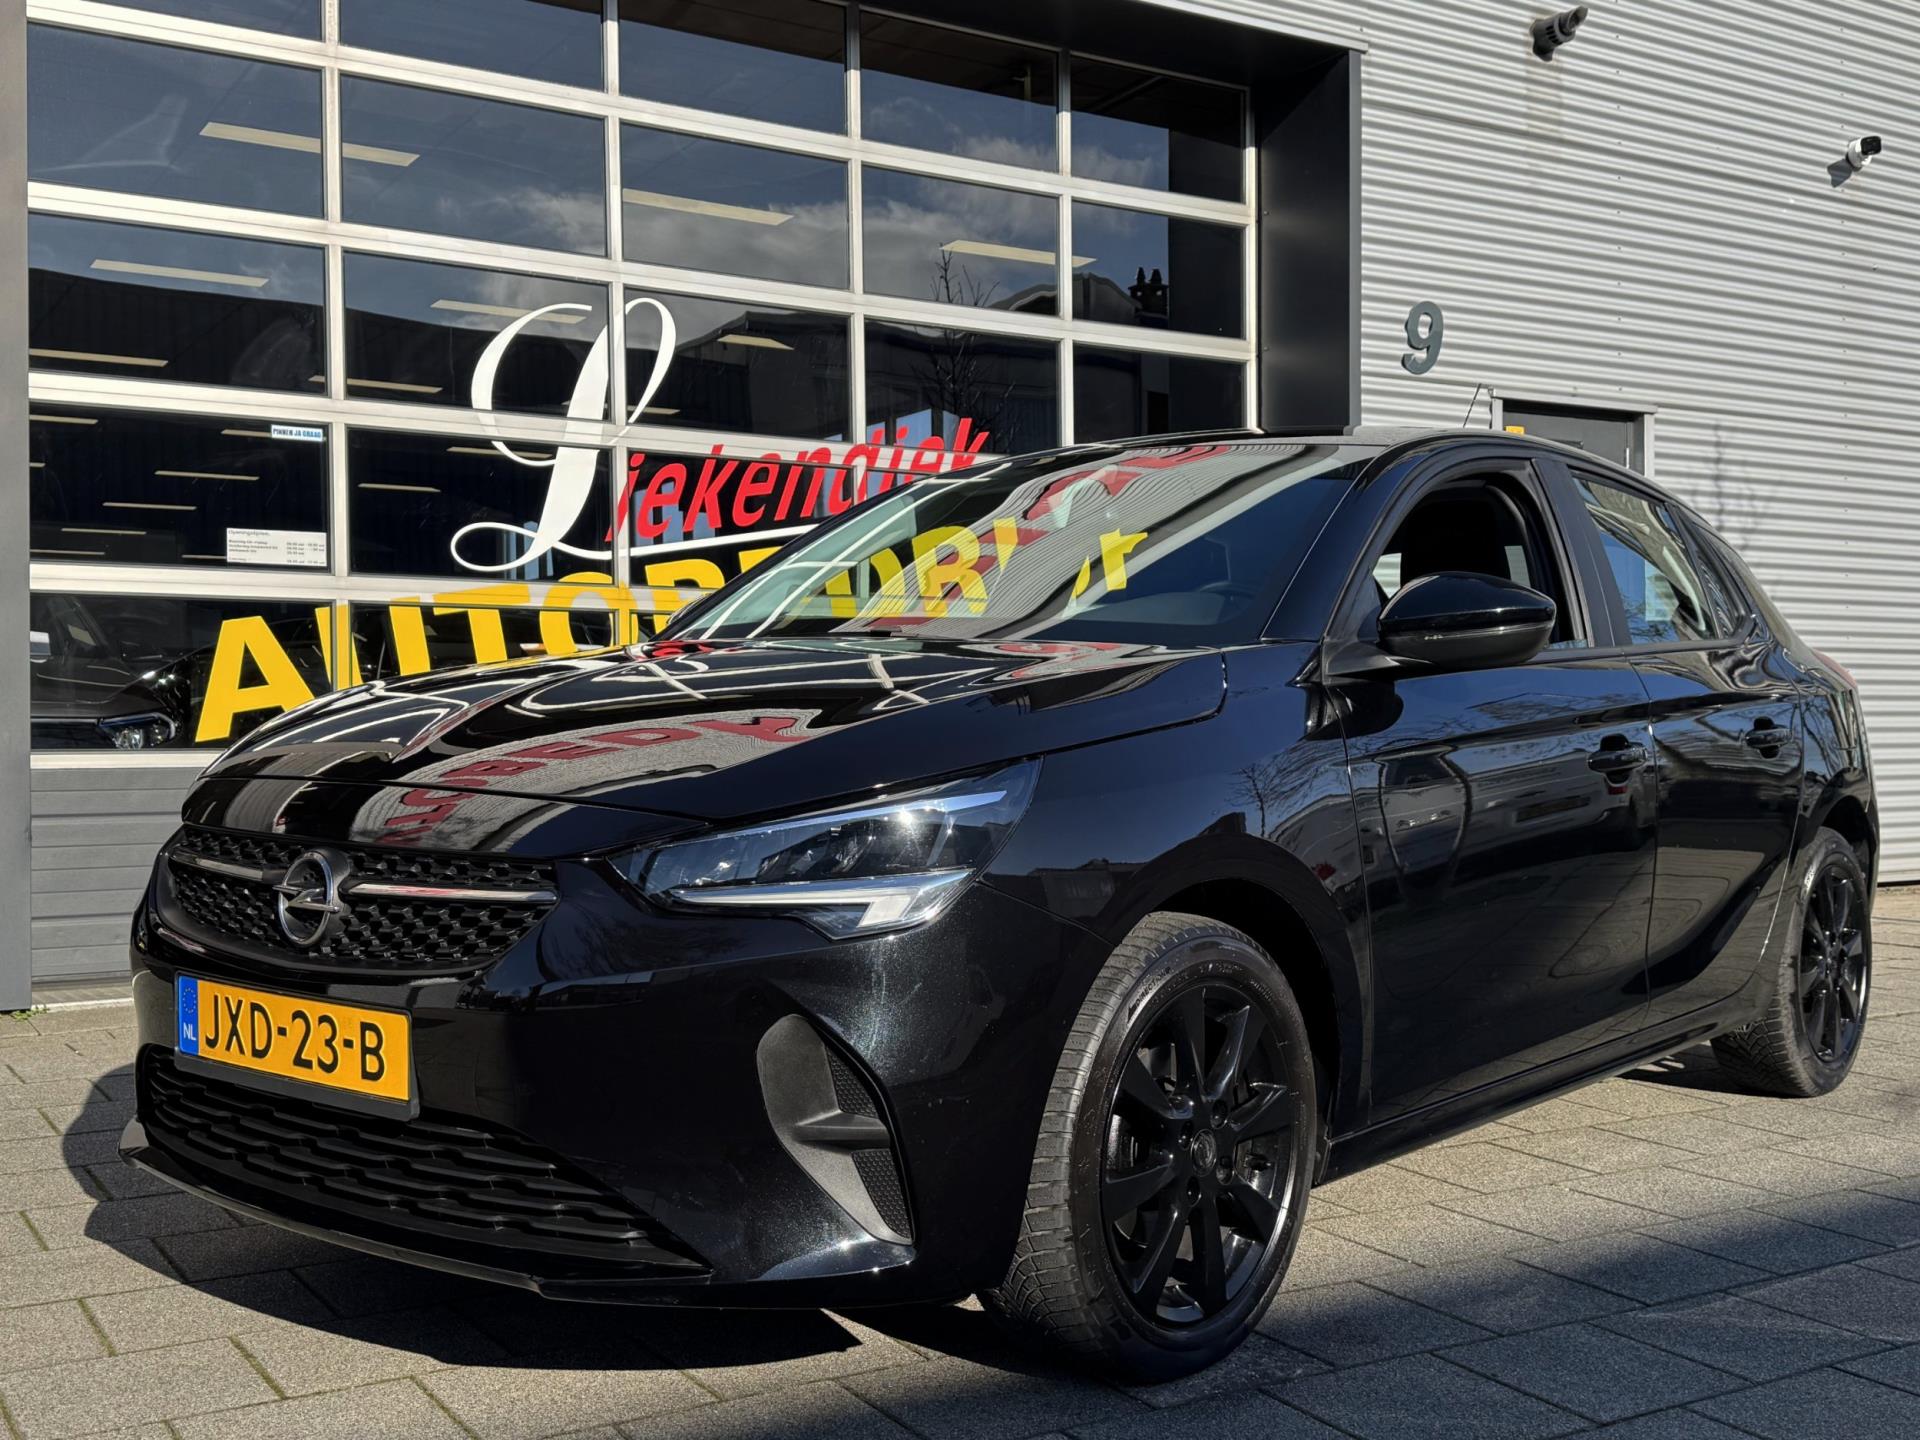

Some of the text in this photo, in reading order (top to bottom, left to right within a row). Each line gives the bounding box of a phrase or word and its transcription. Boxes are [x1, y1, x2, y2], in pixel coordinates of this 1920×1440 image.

[1401, 301, 1444, 375] 9
[183, 994, 386, 1082] NL JXD-23-B
